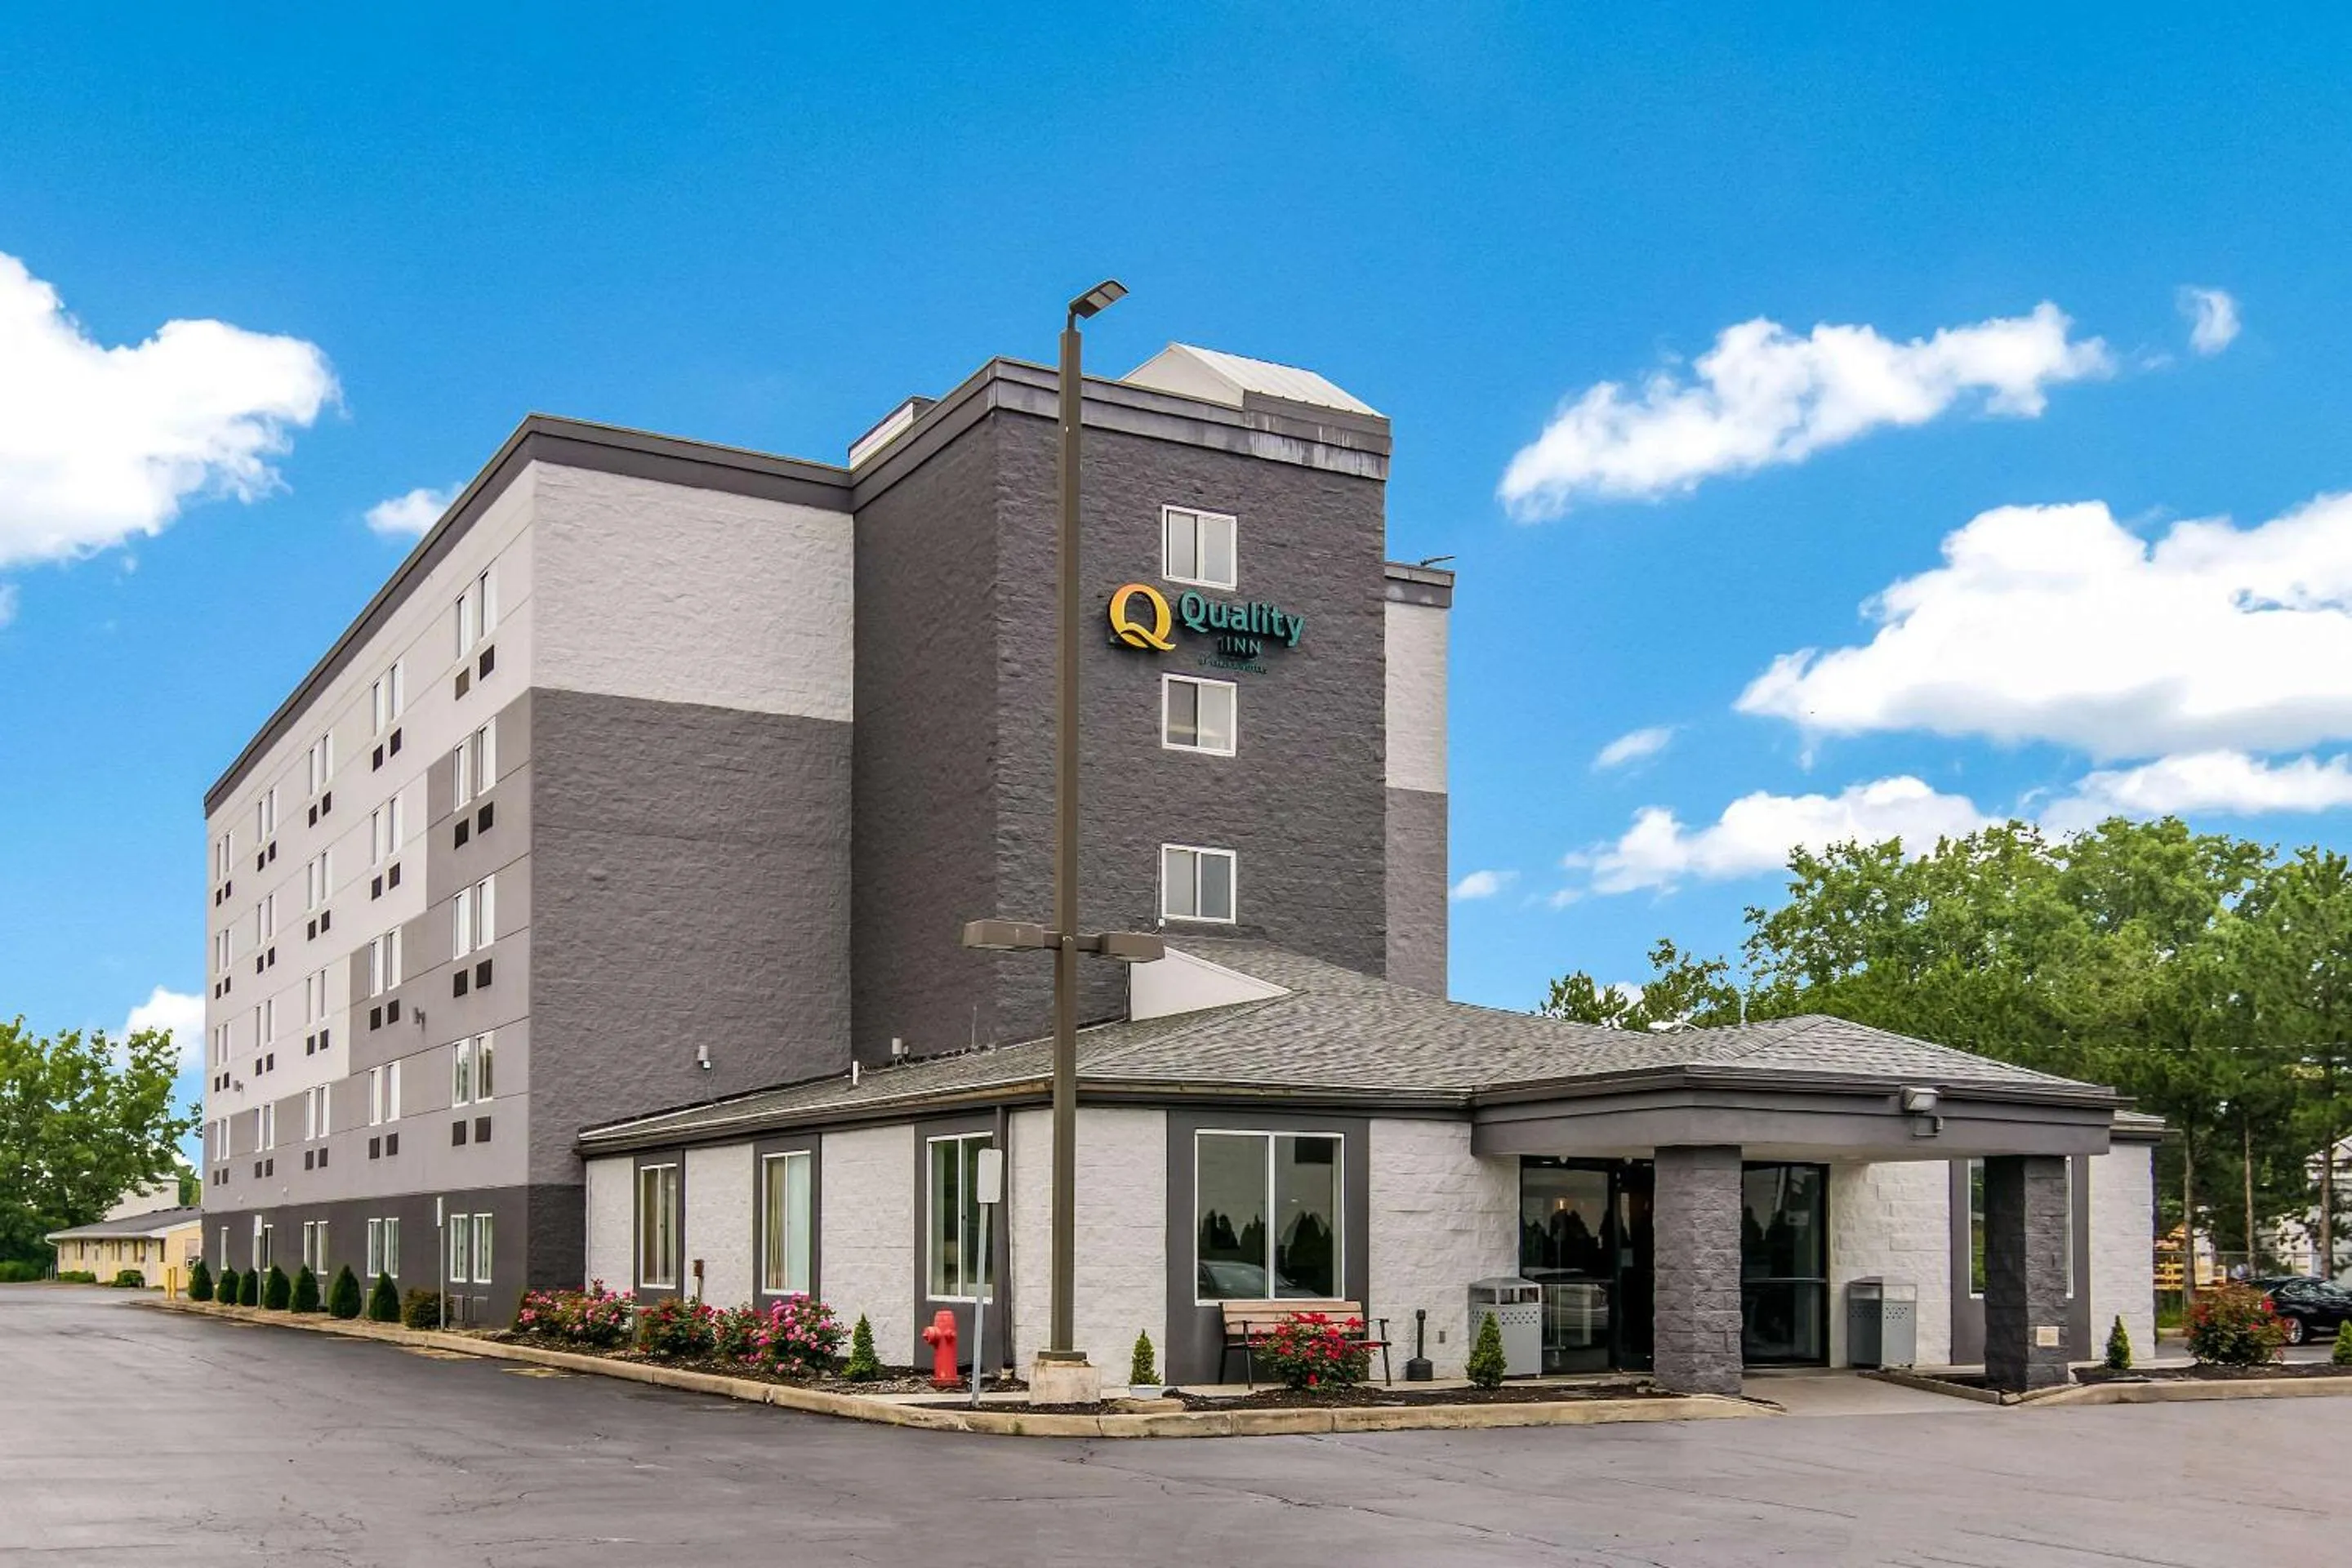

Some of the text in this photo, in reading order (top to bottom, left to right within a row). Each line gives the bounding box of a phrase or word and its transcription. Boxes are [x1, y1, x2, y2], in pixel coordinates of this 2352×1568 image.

[1109, 583, 1176, 651] Q
[1178, 590, 1305, 648] Quality
[1226, 635, 1262, 654] INN
